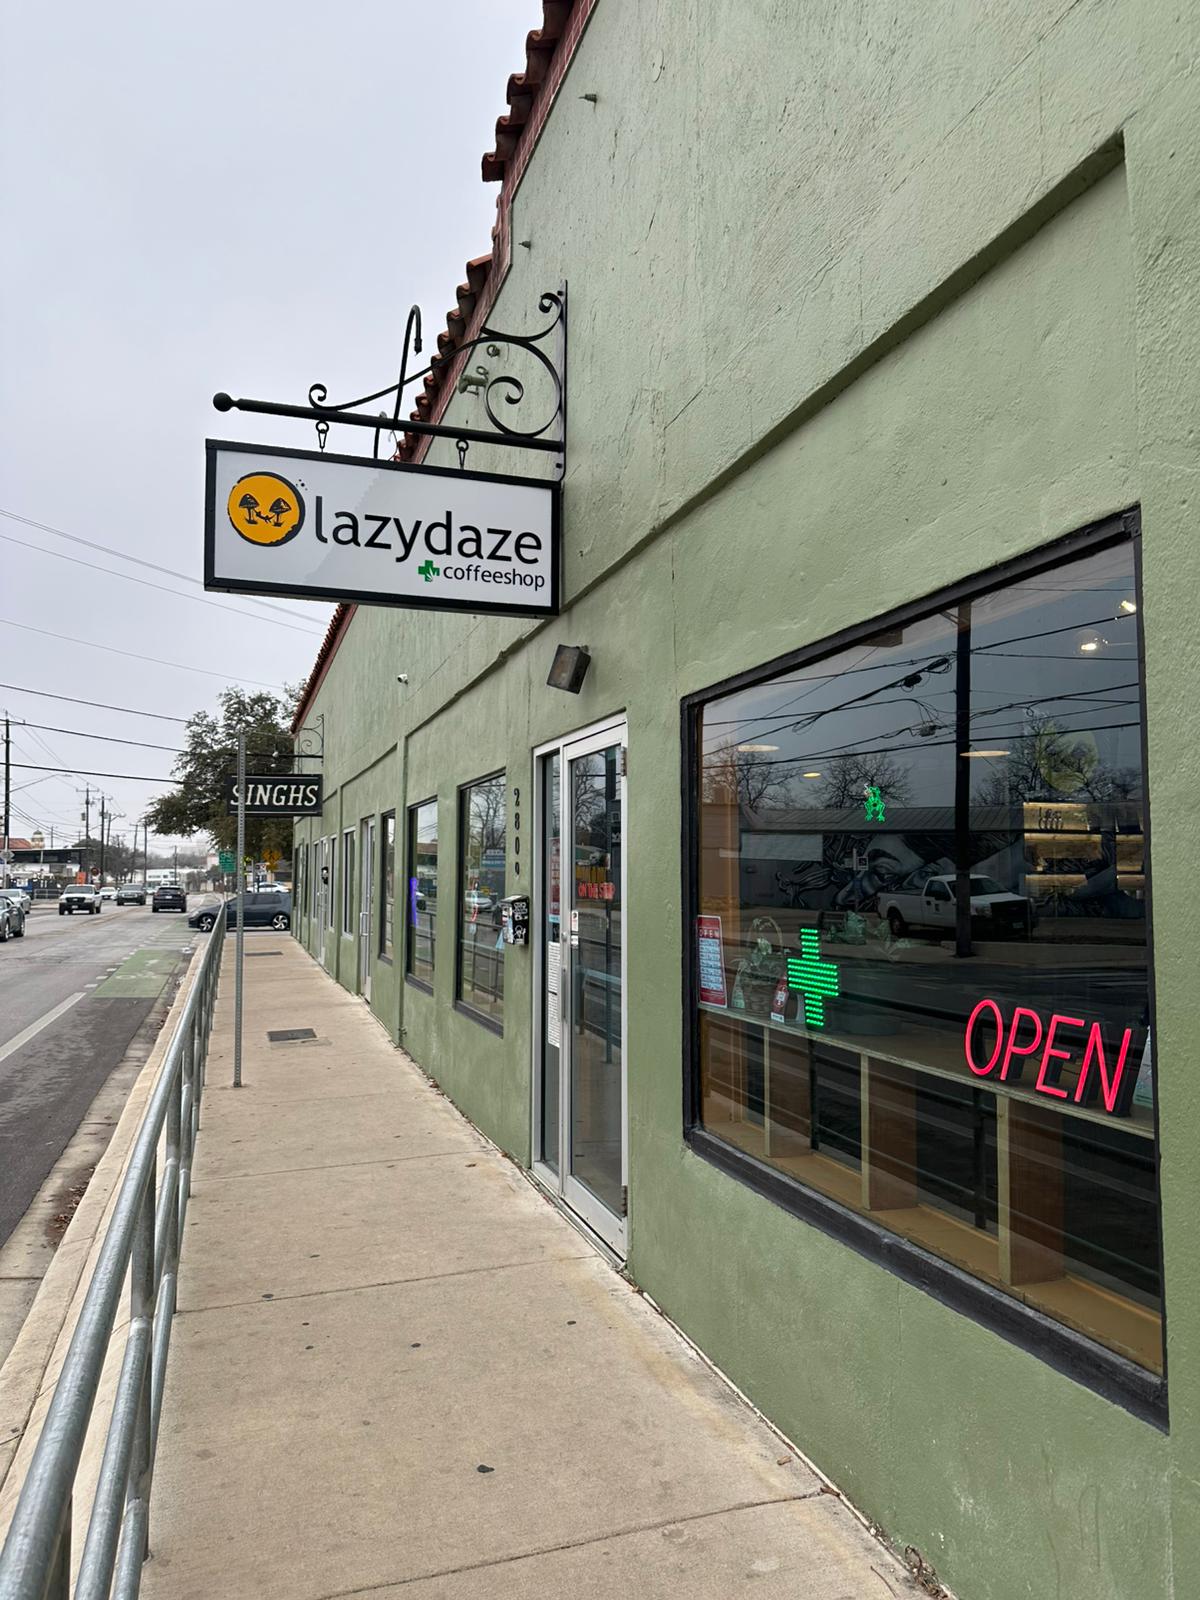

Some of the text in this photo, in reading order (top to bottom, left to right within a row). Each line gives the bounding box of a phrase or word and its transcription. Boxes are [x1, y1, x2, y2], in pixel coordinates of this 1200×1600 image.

[315, 495, 543, 565] lazydaze
[443, 563, 546, 592] coffeeshop
[229, 784, 319, 807] SINGHS
[964, 998, 1132, 1113] OPEN
